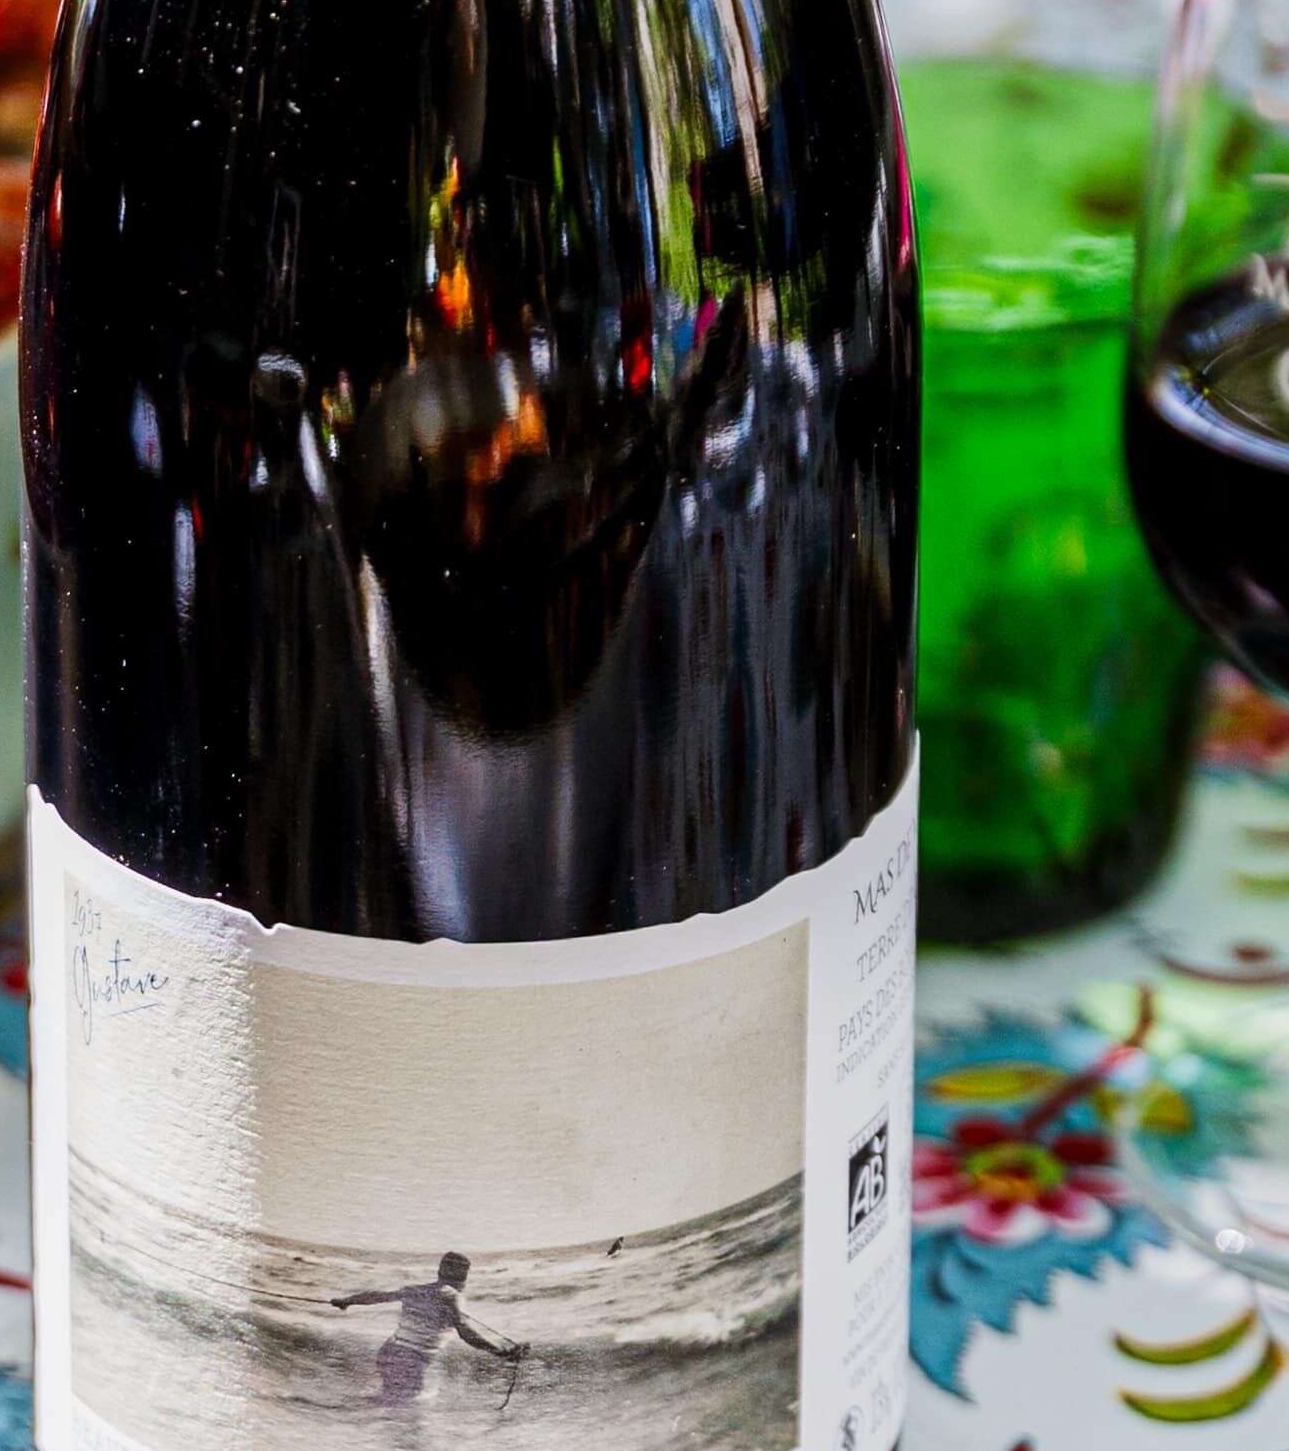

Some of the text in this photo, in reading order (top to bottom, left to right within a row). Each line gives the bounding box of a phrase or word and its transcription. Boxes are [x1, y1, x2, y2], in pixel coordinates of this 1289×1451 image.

[853, 857, 894, 924] MAS
[837, 998, 873, 1053] PAYS
[850, 1153, 885, 1230] AB
